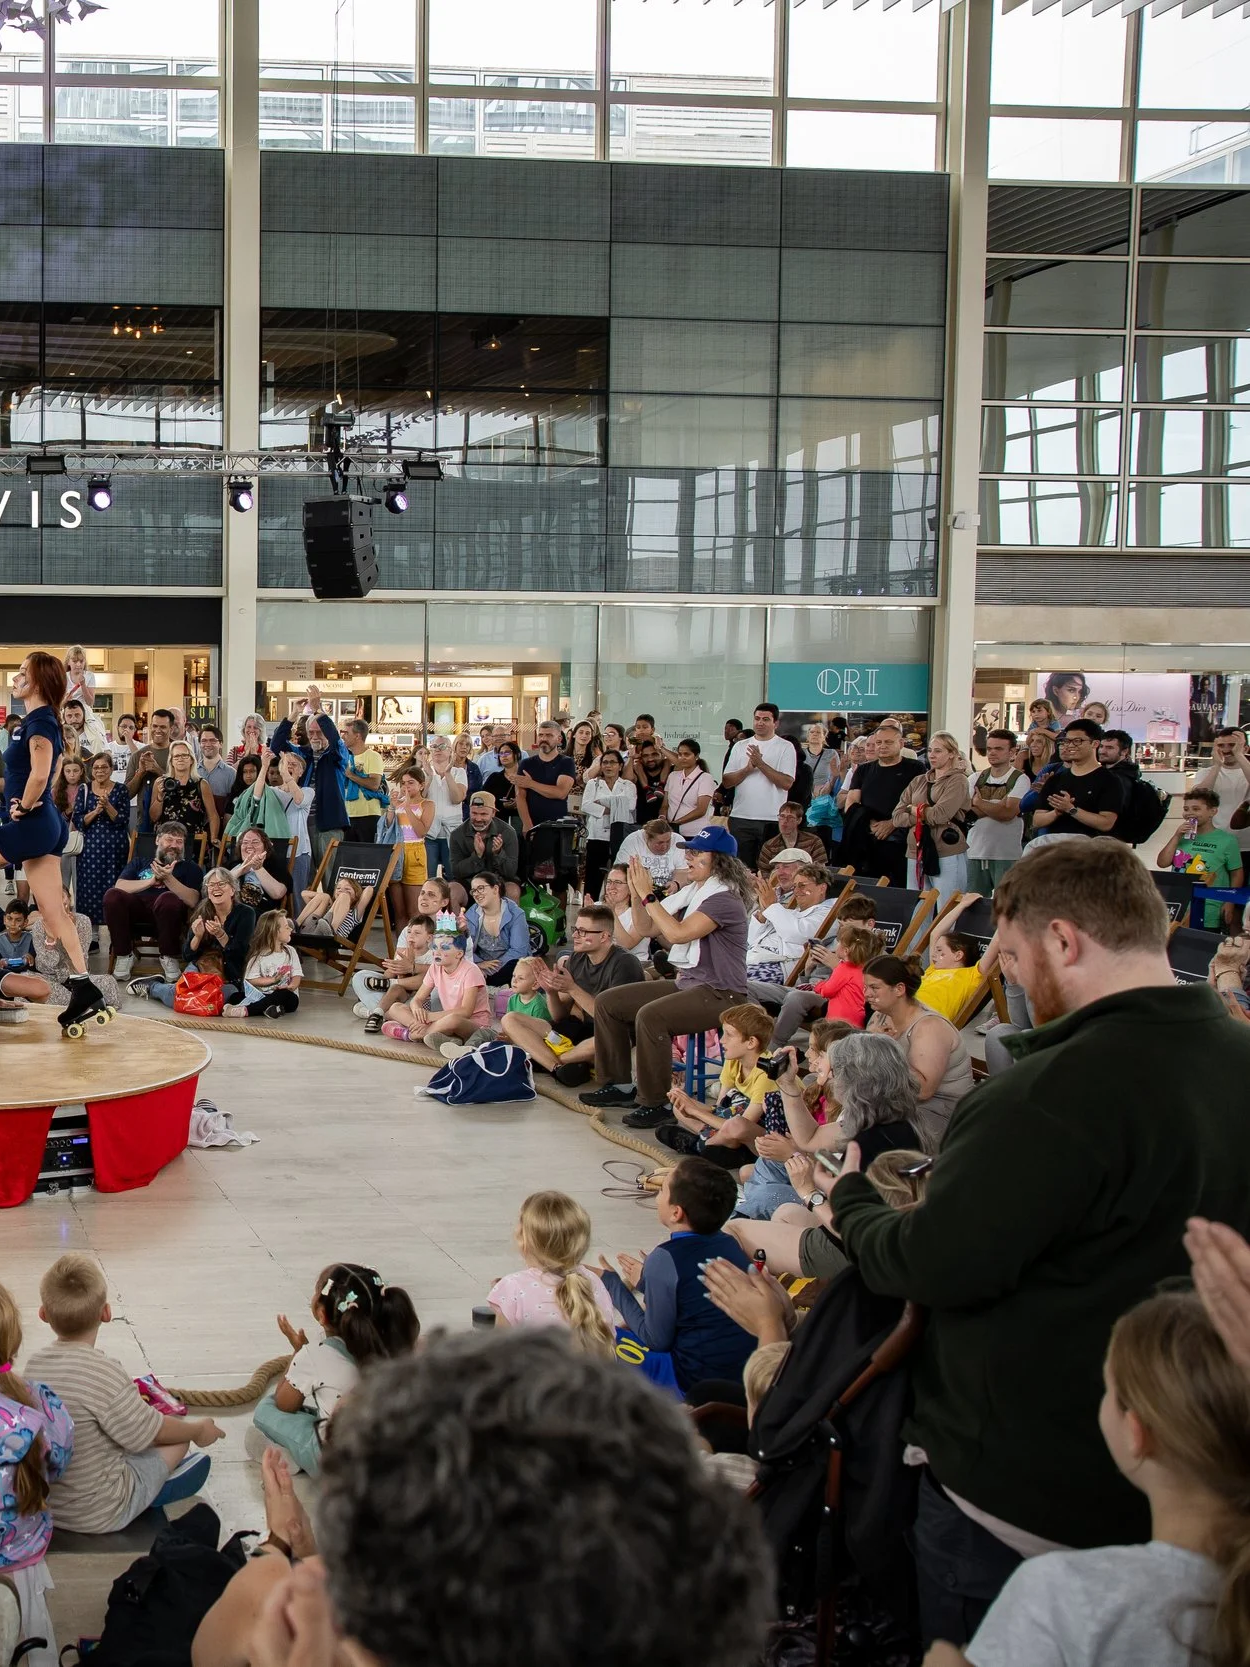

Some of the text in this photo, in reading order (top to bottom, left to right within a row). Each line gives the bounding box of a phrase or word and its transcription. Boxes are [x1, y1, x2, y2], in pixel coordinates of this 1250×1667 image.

[816, 668, 880, 696] ORI
[1124, 700, 1148, 712] Dior
[339, 871, 377, 880] centre:mk
